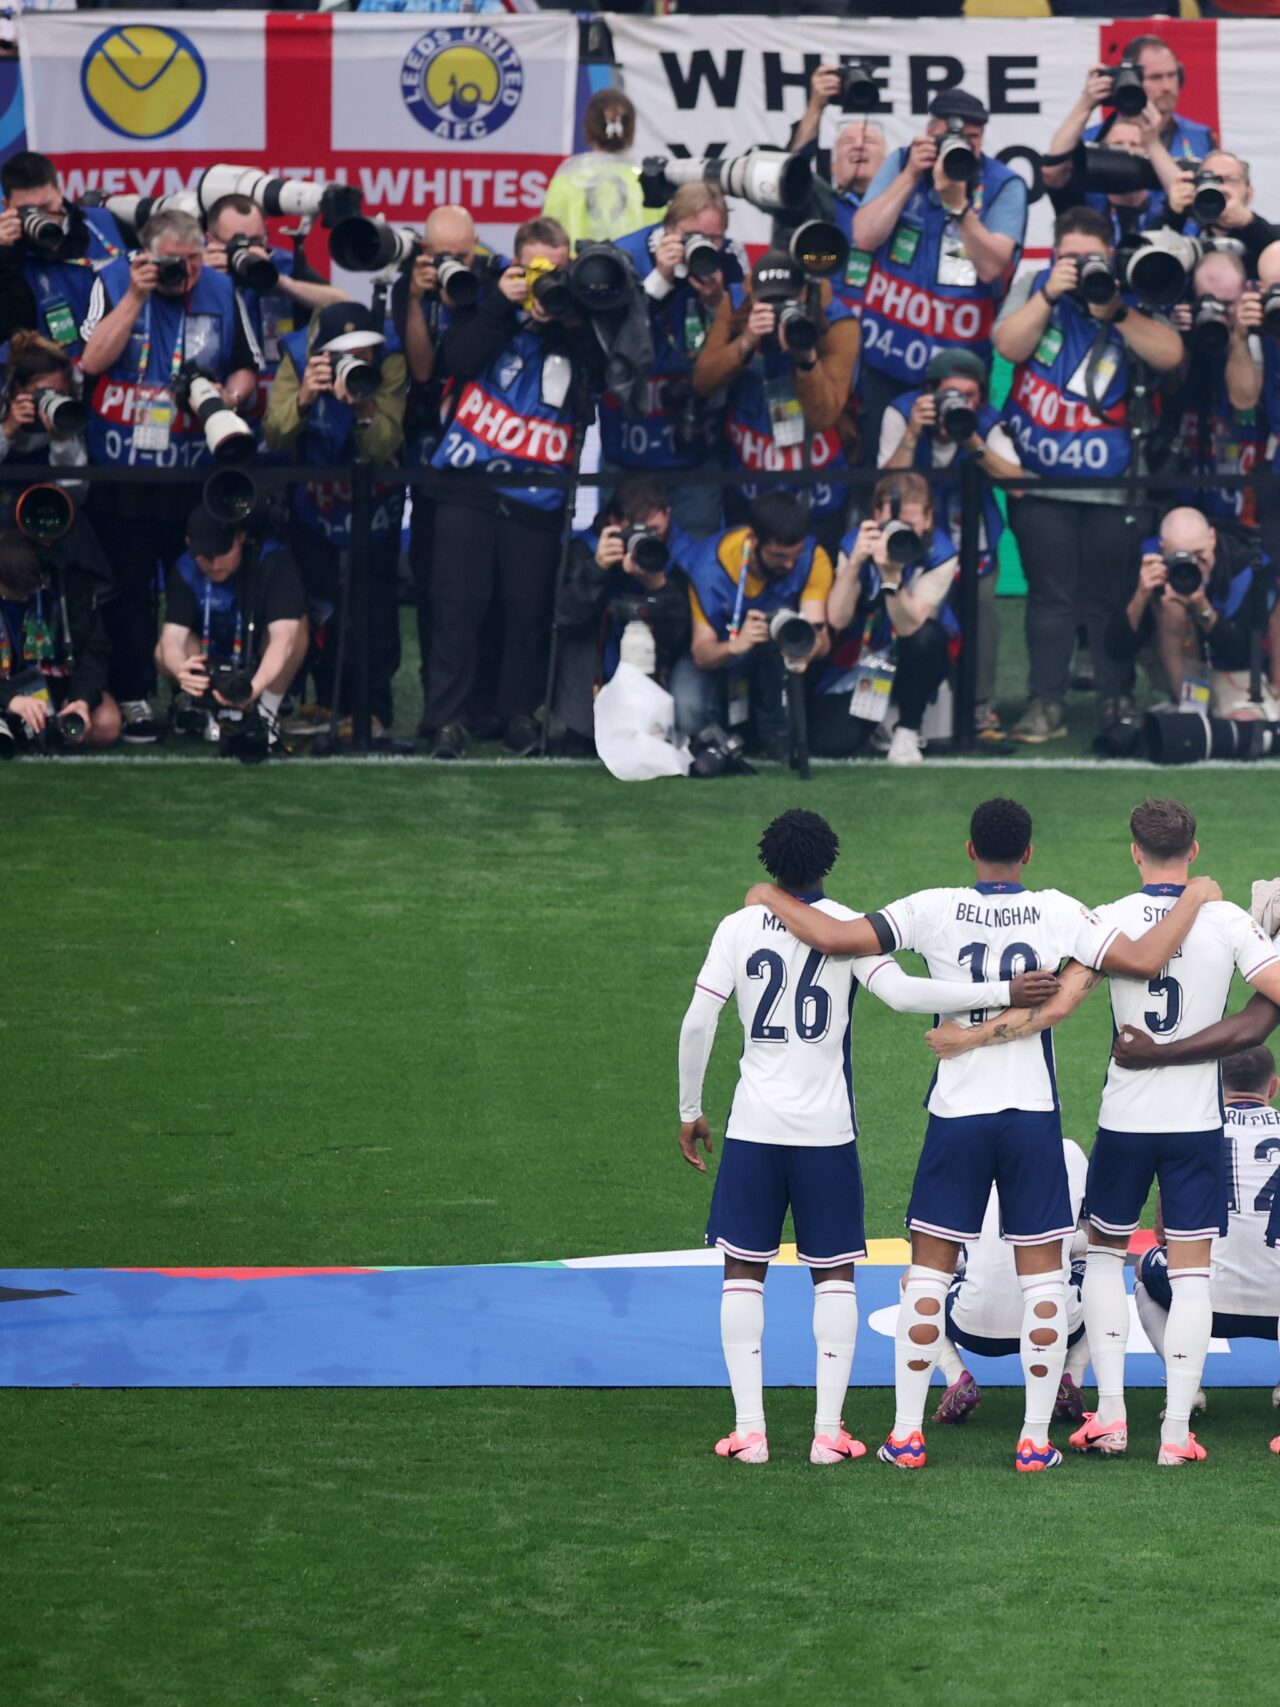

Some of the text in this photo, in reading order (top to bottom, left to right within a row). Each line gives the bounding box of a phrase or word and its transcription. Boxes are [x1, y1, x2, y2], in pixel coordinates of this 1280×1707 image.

[402, 26, 522, 107] LEEDS UNITED
[659, 49, 1041, 114] WHERE
[434, 120, 488, 140] AFC
[56, 166, 549, 208] WEYMTH WHITES
[866, 271, 981, 338] PHOTO
[862, 318, 946, 371] 04-0
[457, 388, 569, 462] PHOTO
[956, 902, 1041, 928] BELLNGHAM
[746, 948, 832, 1044] 26
[1144, 945, 1184, 1036] 5
